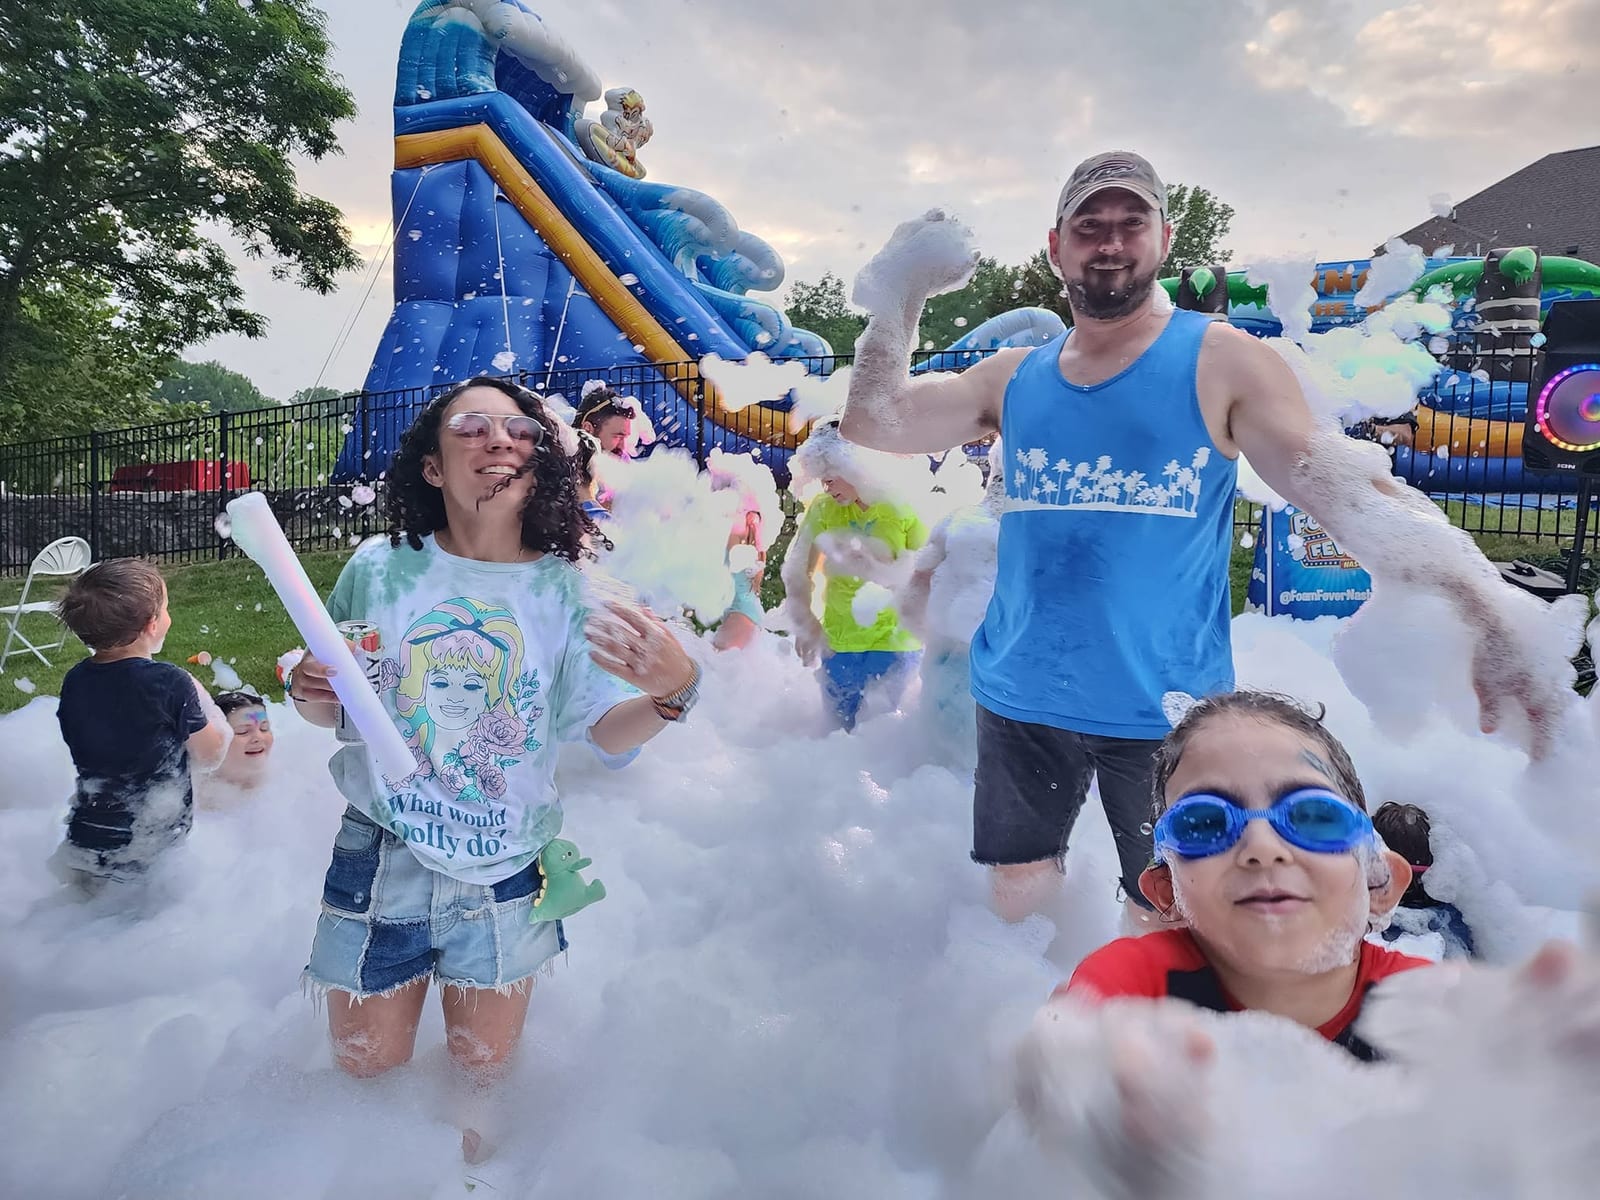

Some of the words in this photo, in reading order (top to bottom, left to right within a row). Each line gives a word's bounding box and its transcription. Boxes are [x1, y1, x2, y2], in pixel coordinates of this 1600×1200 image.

[1312, 302, 1347, 316] HE
[1293, 513, 1322, 535] FO
[1344, 560, 1361, 569] NAS
[366, 656, 380, 698] ULY
[387, 793, 443, 817] What
[448, 807, 507, 827] would
[390, 820, 460, 859] Dolly
